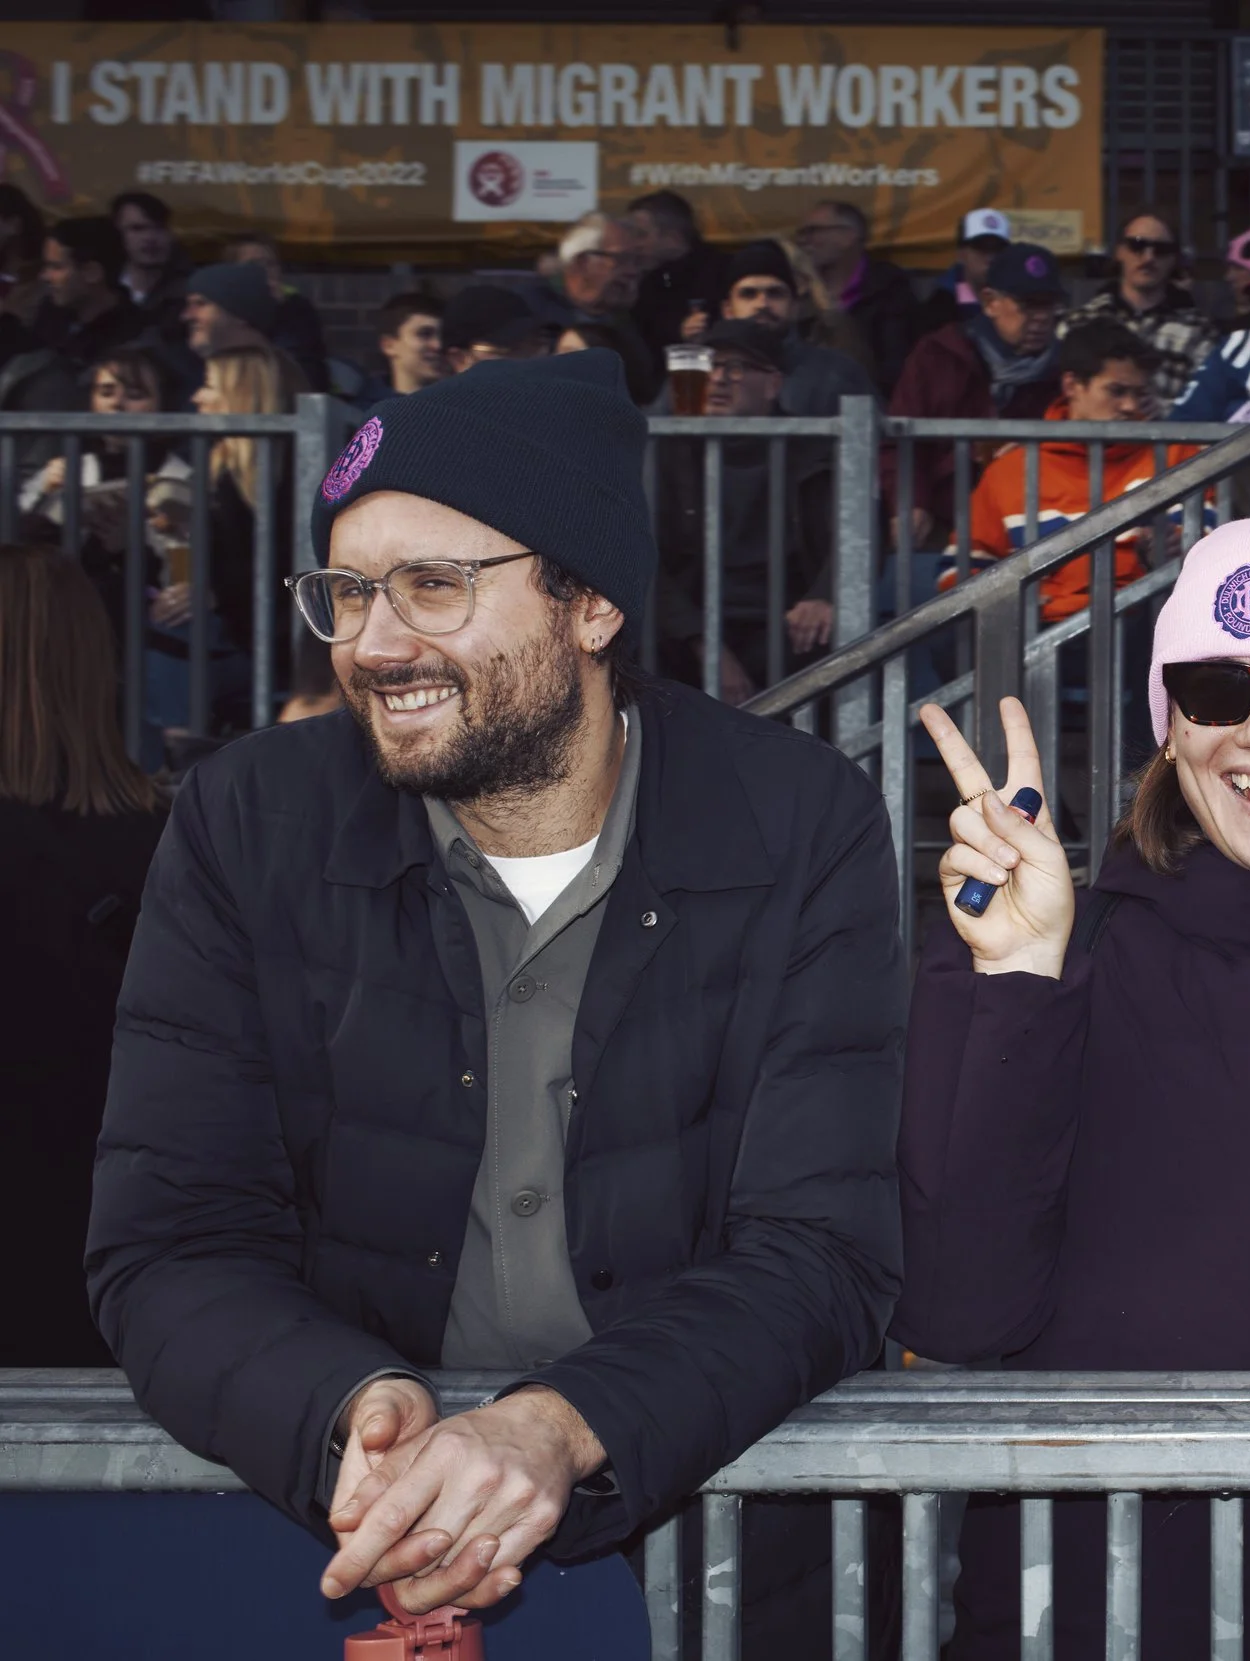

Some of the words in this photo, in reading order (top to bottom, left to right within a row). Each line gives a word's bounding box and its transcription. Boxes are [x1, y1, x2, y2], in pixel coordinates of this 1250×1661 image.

[52, 62, 71, 124] I
[89, 61, 290, 125] STAND
[306, 62, 460, 127] WITH
[481, 62, 762, 128] MIGRANT
[777, 64, 1082, 129] WORKERS
[136, 160, 427, 190] #FIFAWorldCup2022
[629, 162, 940, 191] #WithMigrantWorkers
[1221, 572, 1249, 604] DULWICH
